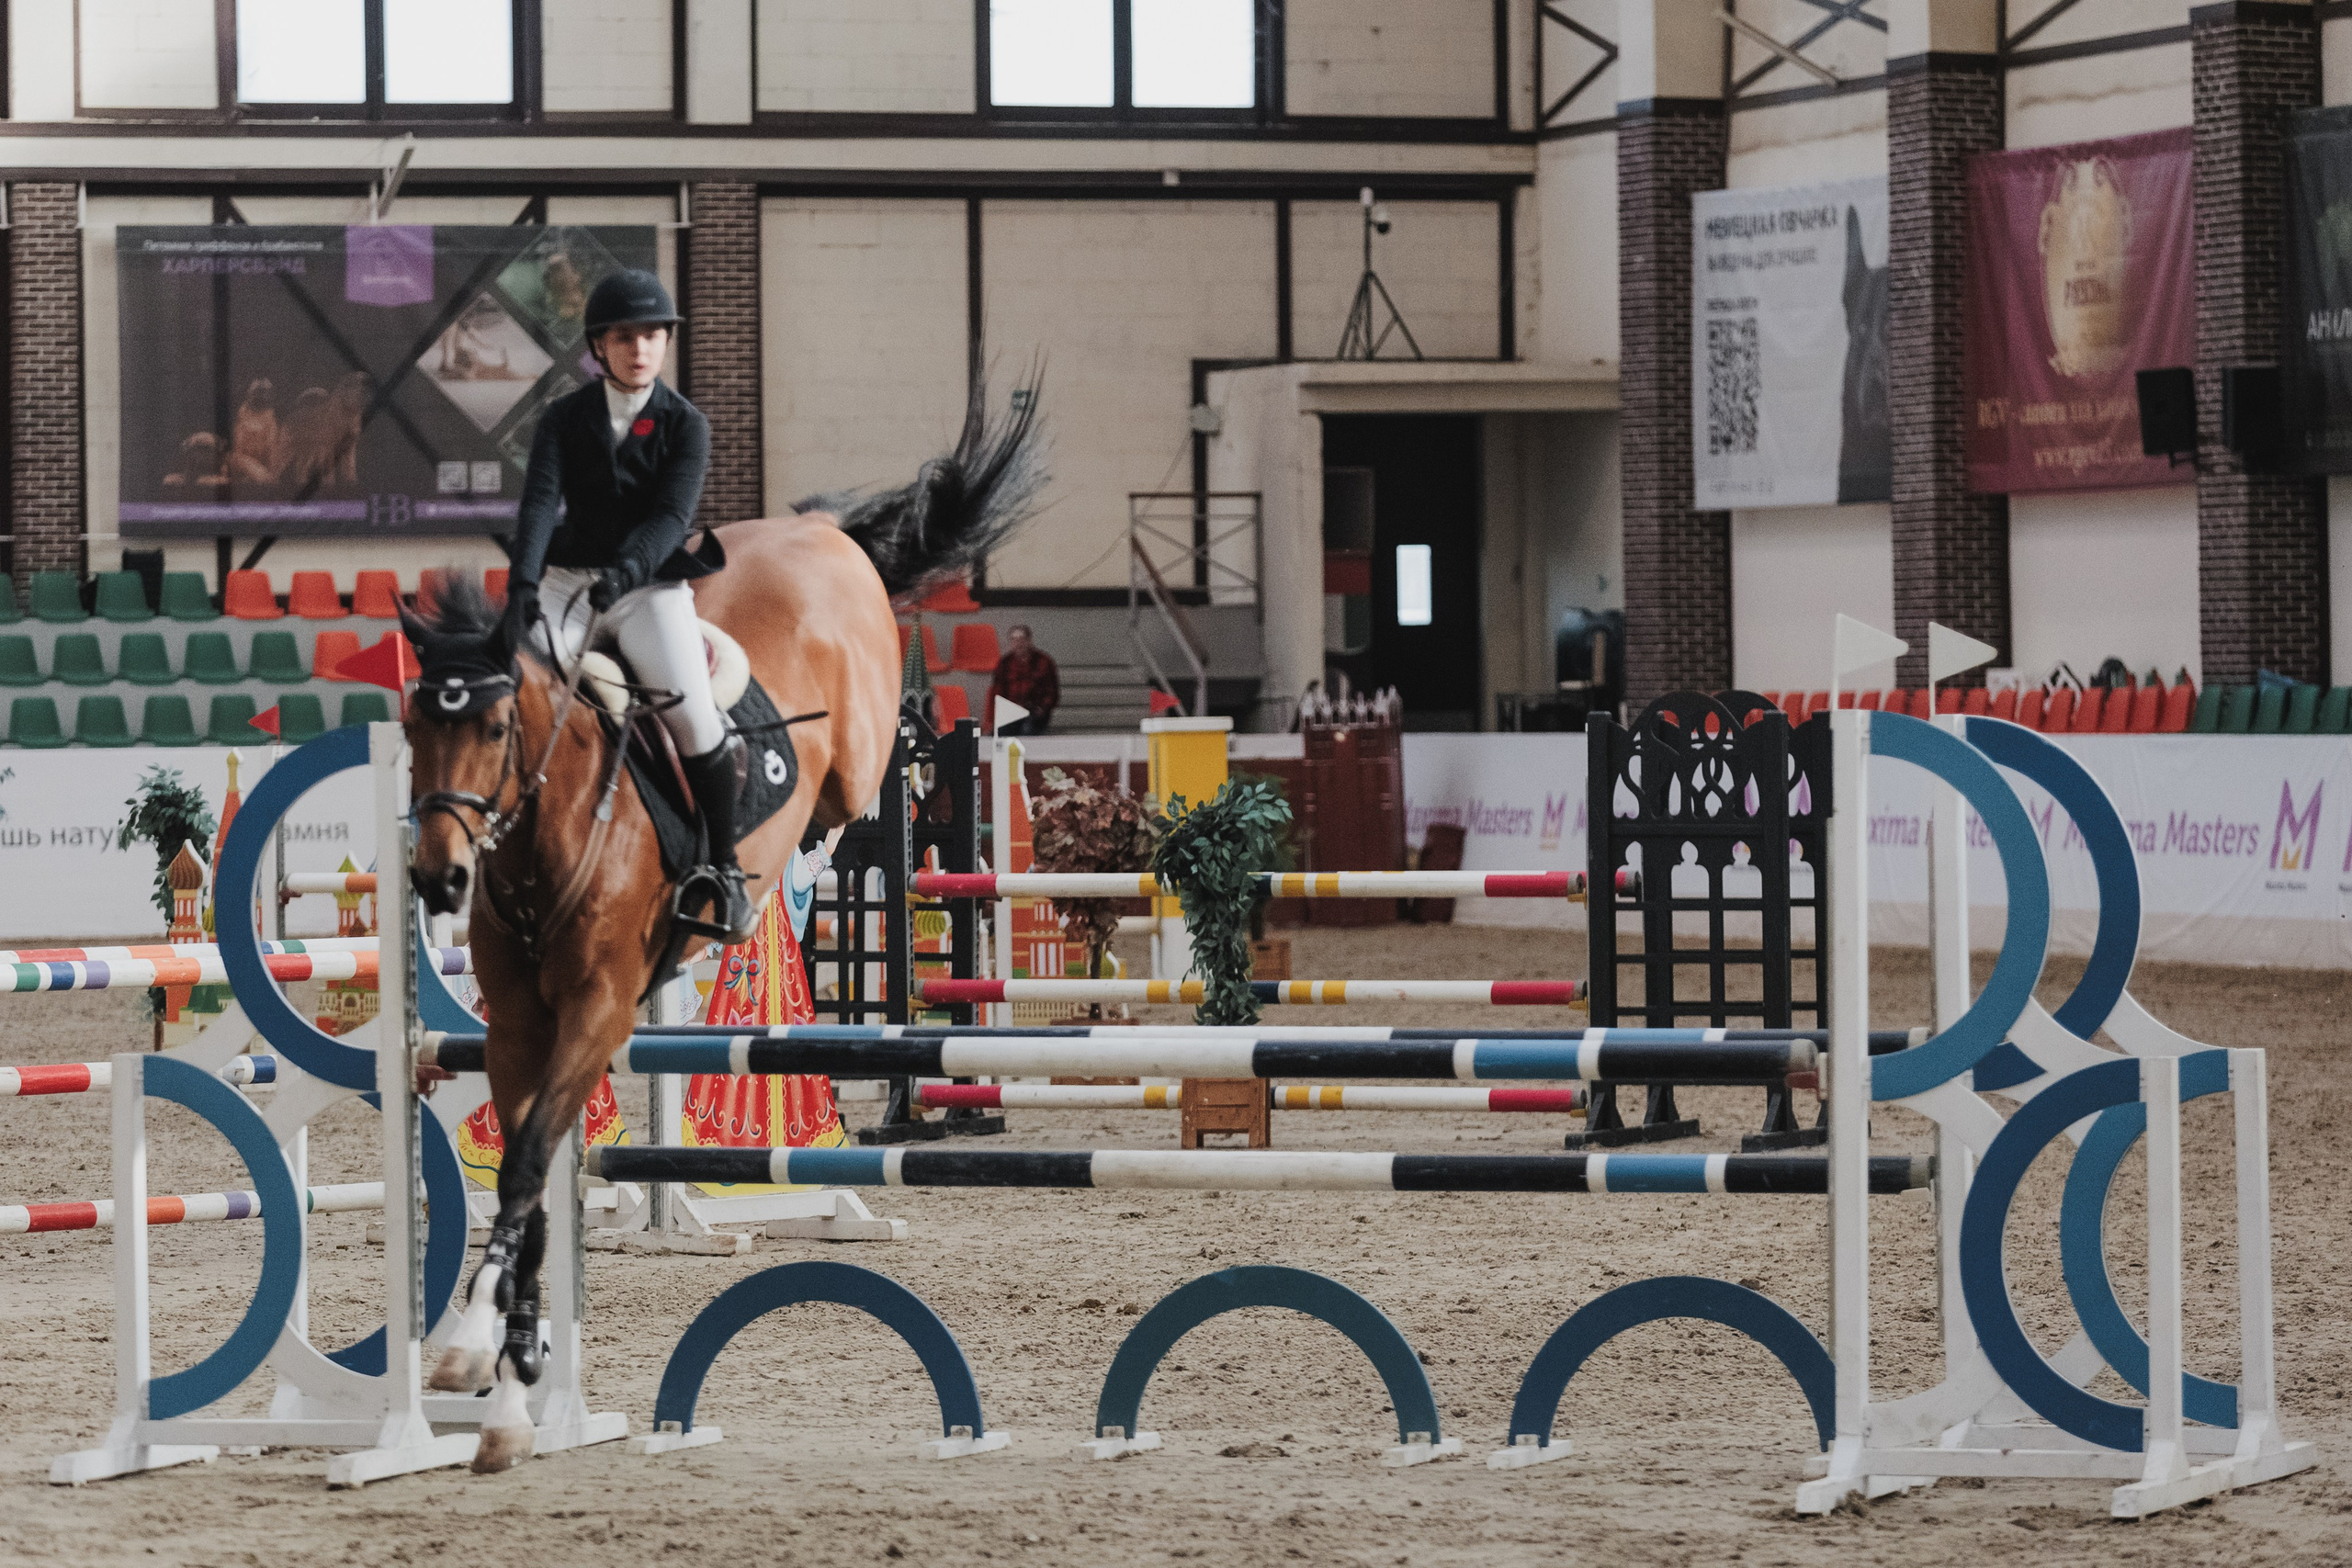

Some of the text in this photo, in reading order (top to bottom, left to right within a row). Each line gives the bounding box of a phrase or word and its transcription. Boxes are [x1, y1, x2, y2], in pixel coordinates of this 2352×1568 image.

[51, 827, 113, 854] нату
[283, 822, 349, 841] амня
[1868, 804, 1920, 846] xima
[2163, 810, 2260, 855] Masters
